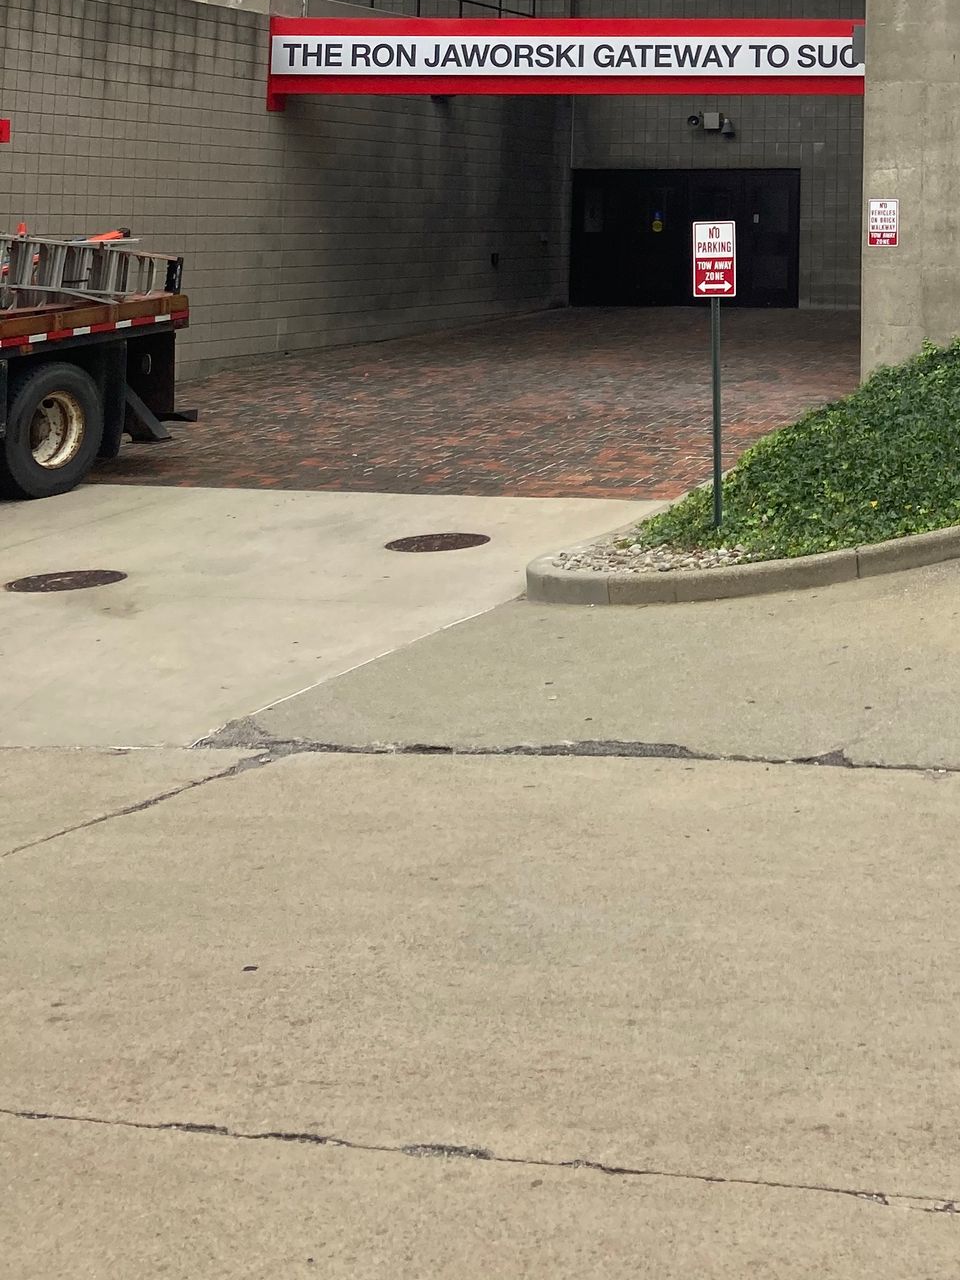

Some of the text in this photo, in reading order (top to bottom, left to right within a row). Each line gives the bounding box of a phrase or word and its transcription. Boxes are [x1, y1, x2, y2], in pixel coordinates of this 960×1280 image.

[282, 43, 343, 67] THE
[350, 43, 417, 67] RON
[424, 43, 585, 68] JAWORSKI
[593, 43, 742, 68] GATEWAY
[749, 44, 790, 68] TO
[708, 227, 720, 239] NO
[697, 241, 732, 253] PARKING
[697, 261, 732, 270] TOW AWAY
[705, 271, 724, 281] ZONE
